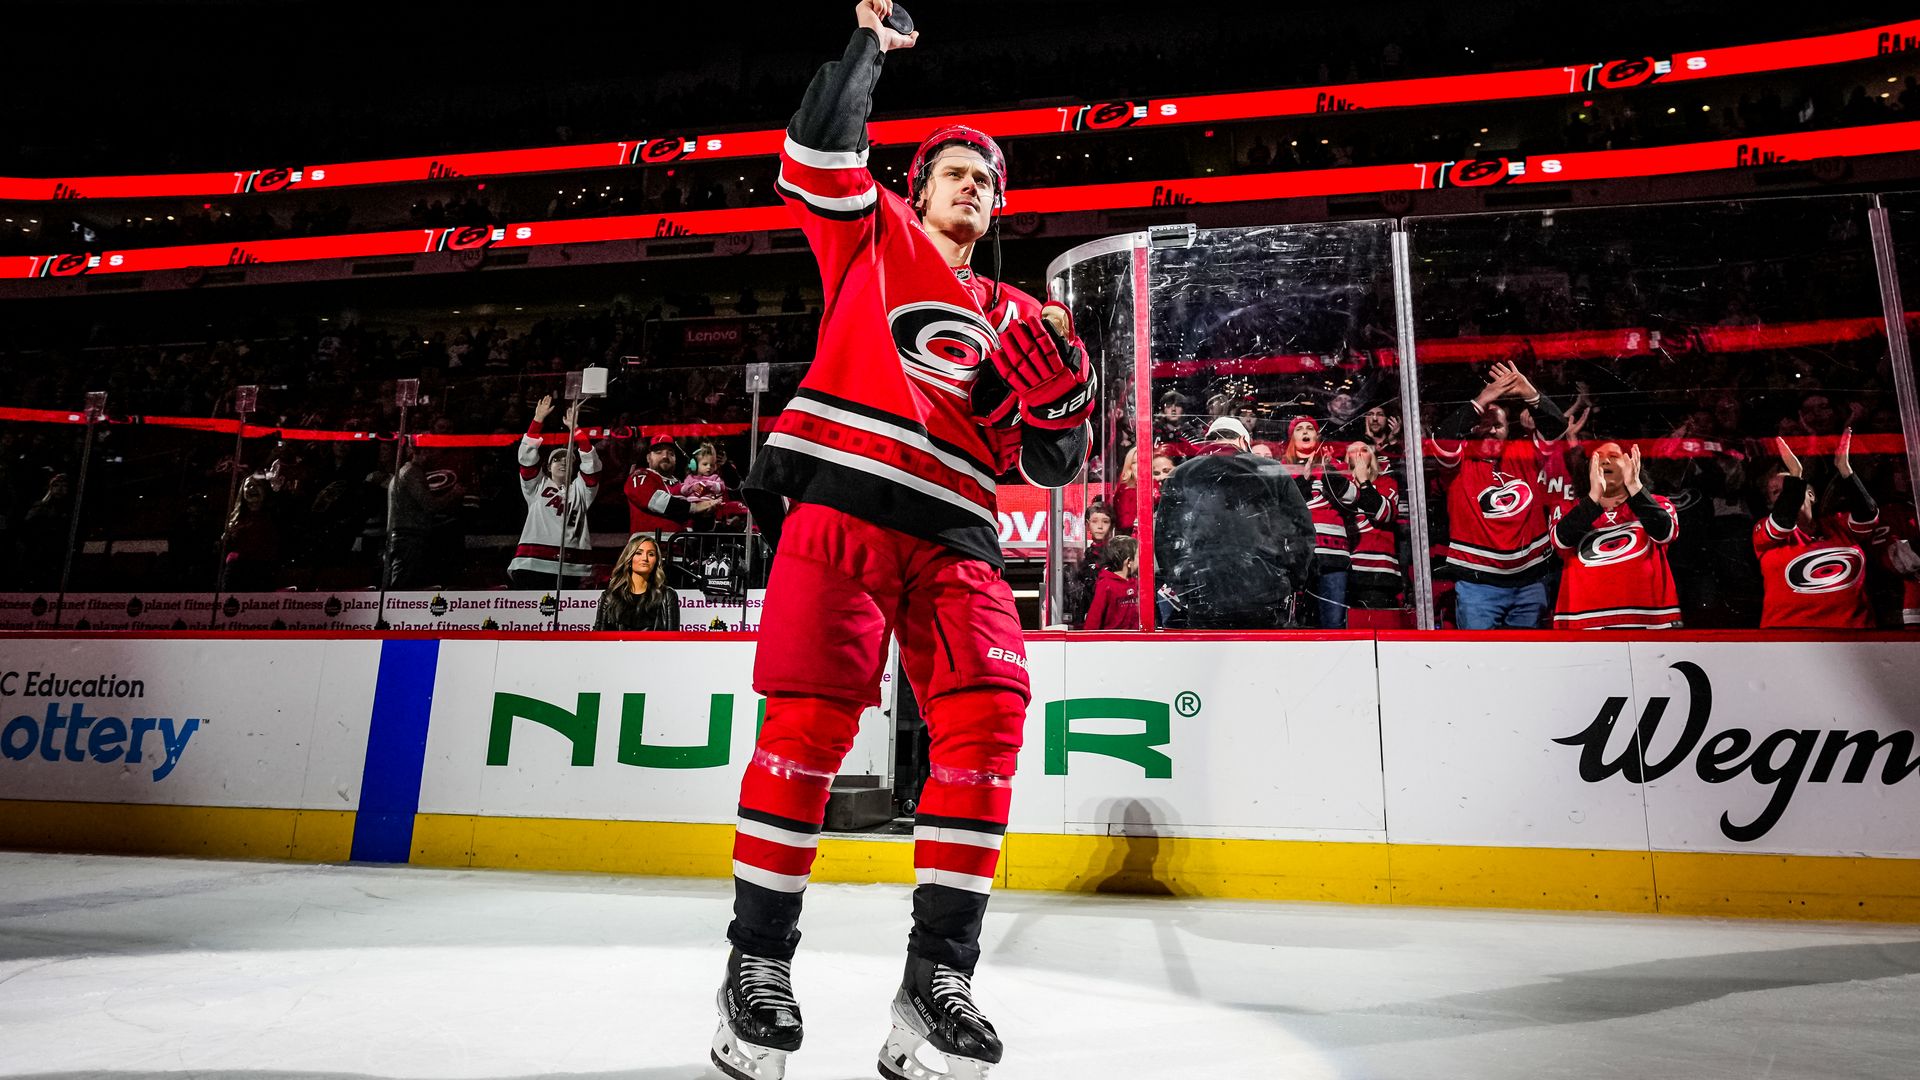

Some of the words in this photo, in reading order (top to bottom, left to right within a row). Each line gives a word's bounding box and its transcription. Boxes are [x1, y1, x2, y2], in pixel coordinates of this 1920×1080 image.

[687, 330, 737, 341] Lenovo
[632, 474, 647, 488] 17
[1537, 469, 1575, 500] ANE
[541, 487, 579, 527] CANE
[48, 600, 85, 612] panet
[87, 599, 126, 610] fitness
[144, 599, 181, 613] planet
[241, 599, 280, 612] planet
[283, 598, 323, 610] fitness
[343, 598, 381, 612] plane
[386, 598, 429, 610] fitness
[449, 597, 490, 612] planet
[493, 597, 538, 610] fitness
[23, 672, 144, 698] Education
[1, 702, 200, 782] ottery
[1551, 661, 1920, 842] Wegm
